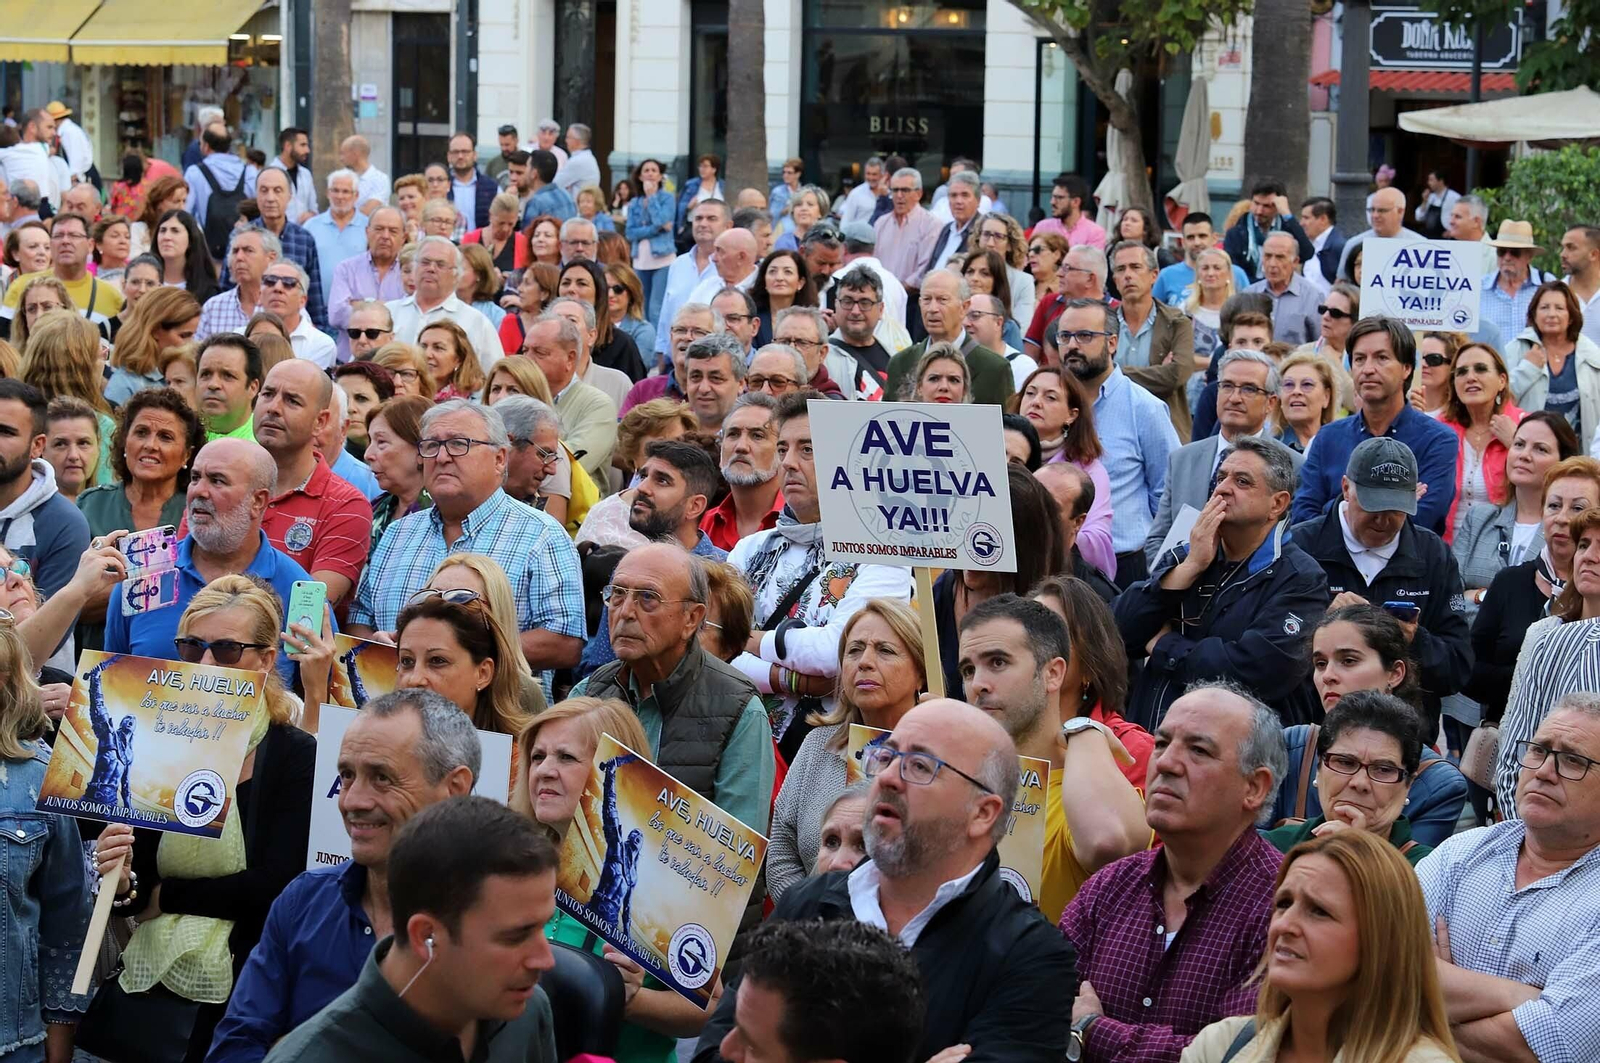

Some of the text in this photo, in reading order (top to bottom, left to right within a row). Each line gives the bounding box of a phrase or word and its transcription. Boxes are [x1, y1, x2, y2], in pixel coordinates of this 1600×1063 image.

[870, 116, 929, 134] BLISS
[1393, 249, 1451, 269] AVE
[1370, 274, 1472, 291] A HUELVA
[1398, 296, 1441, 310] YA!!!
[860, 419, 954, 458] AVE
[830, 466, 996, 497] A HUELVA
[877, 504, 950, 532] YA!!!
[832, 541, 958, 559] JUNTOS SOMOS IMPARABLES
[146, 668, 256, 698] AVE, HUELVA
[157, 700, 178, 720] que
[180, 702, 199, 716] van
[201, 706, 210, 716] a
[211, 700, 250, 721] luchar
[44, 796, 169, 824] JUNTOS SOMOS IMPARABLES
[1012, 792, 1040, 816] char
[656, 788, 756, 865] AVE, HUELVA
[662, 828, 684, 847] que
[683, 840, 702, 858] van
[703, 854, 712, 866] a
[712, 852, 748, 886] luchar
[554, 888, 664, 970] JUNTOS SOMOS IMPARABLES
